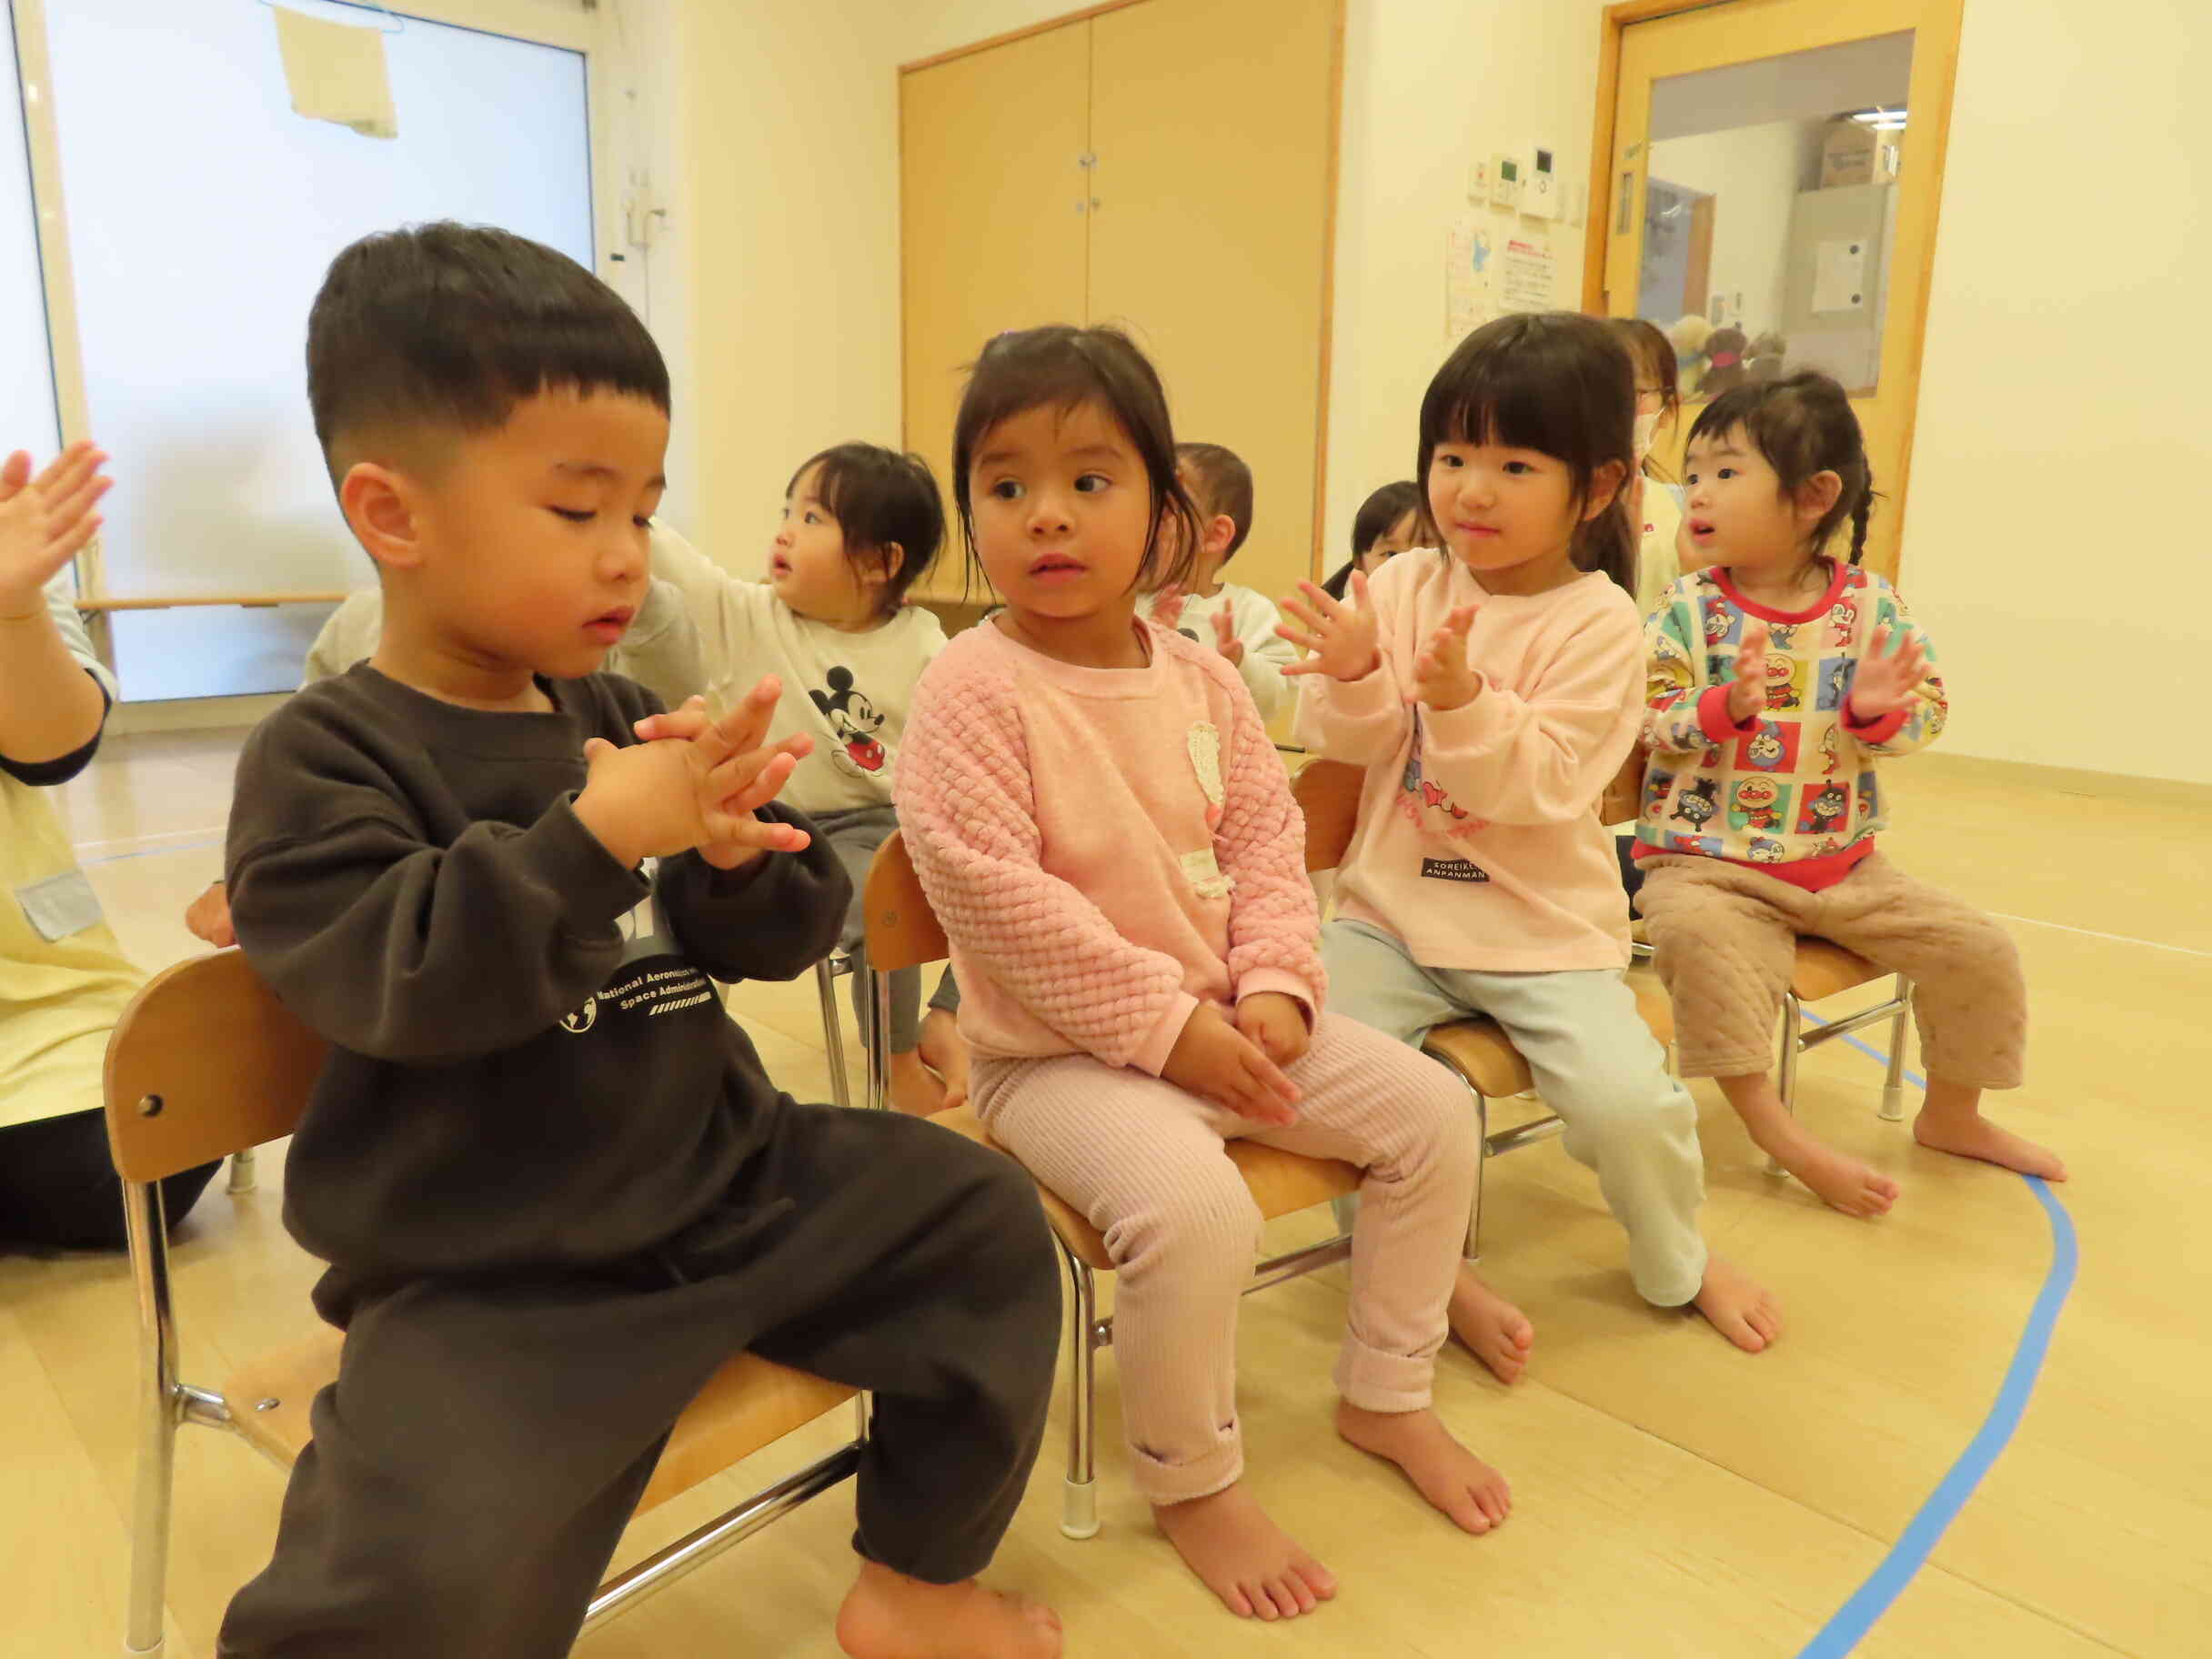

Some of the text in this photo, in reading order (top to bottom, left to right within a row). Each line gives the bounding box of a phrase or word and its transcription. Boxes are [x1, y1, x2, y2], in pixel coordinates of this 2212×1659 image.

[1426, 868, 1484, 879] ANPANMAN
[597, 977, 643, 1000] National
[619, 990, 657, 1009] Space
